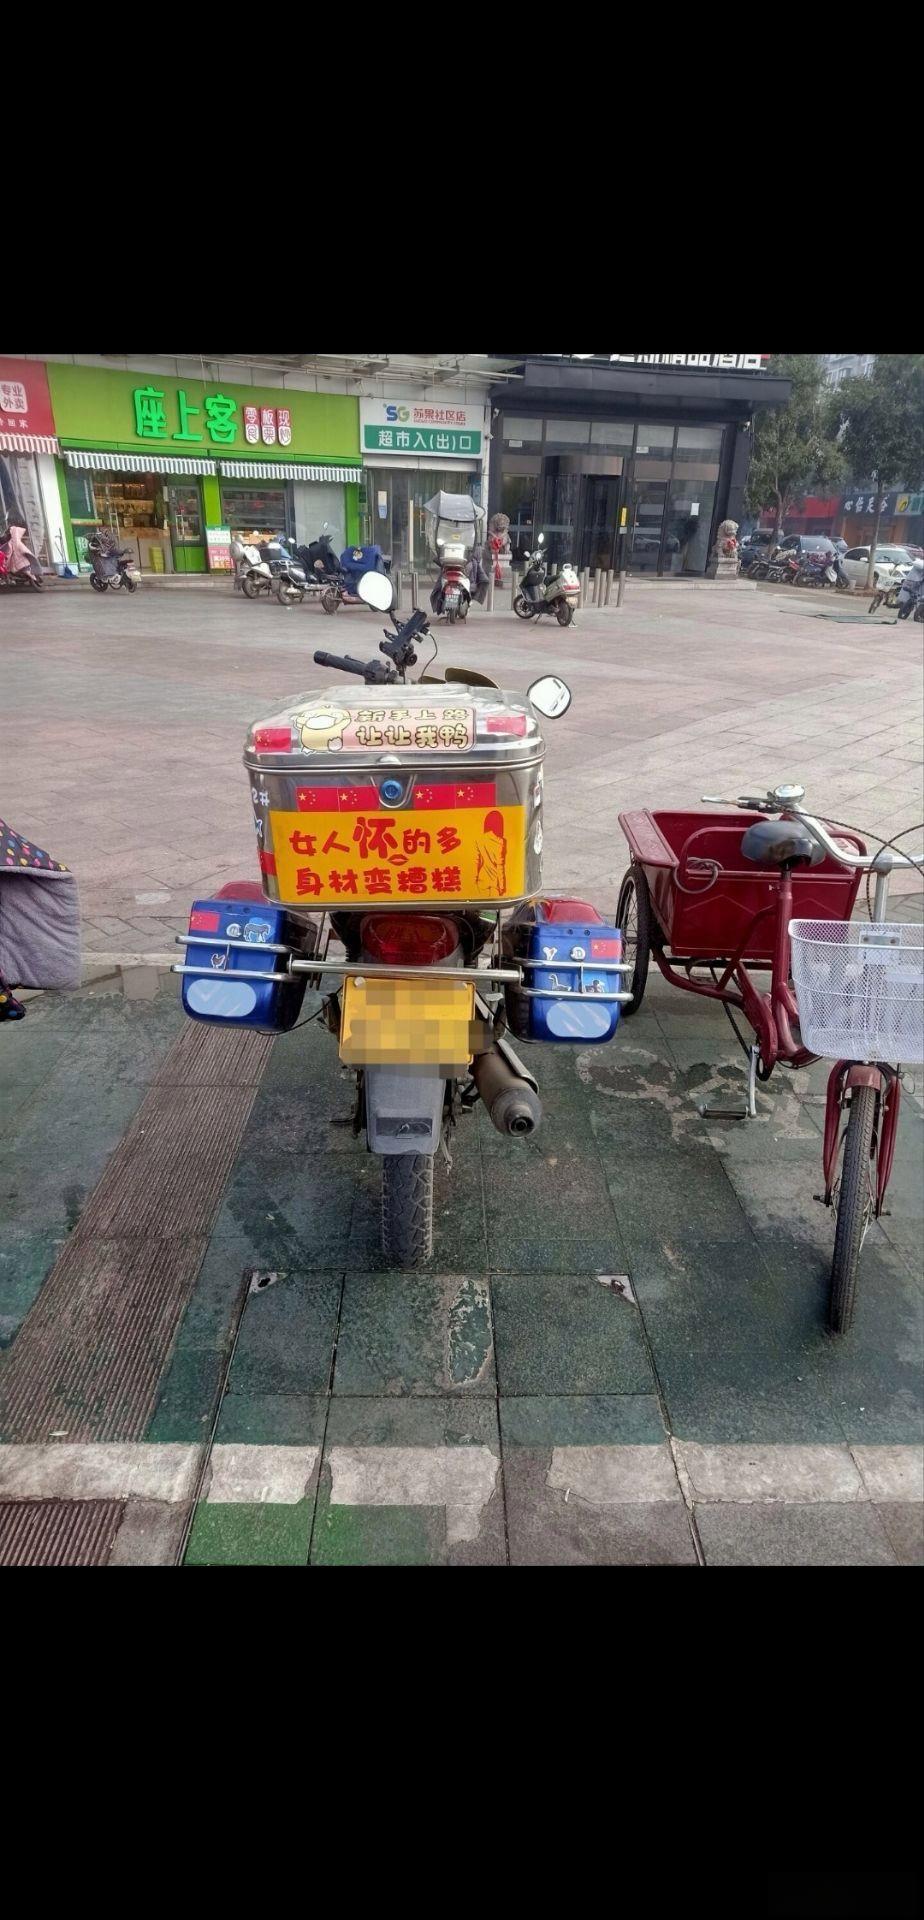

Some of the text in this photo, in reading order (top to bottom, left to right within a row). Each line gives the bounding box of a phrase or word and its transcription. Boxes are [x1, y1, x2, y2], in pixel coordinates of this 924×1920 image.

[1, 384, 23, 397] 专业
[2, 397, 25, 410] 外卖
[134, 385, 238, 443] 座上客
[386, 405, 466, 422] SG 苏果社区店
[355, 708, 469, 732] 新手上路
[355, 723, 469, 749] 让让我鸭
[289, 817, 463, 859] 女人怀的多
[295, 866, 462, 897] 身材变糟糕
